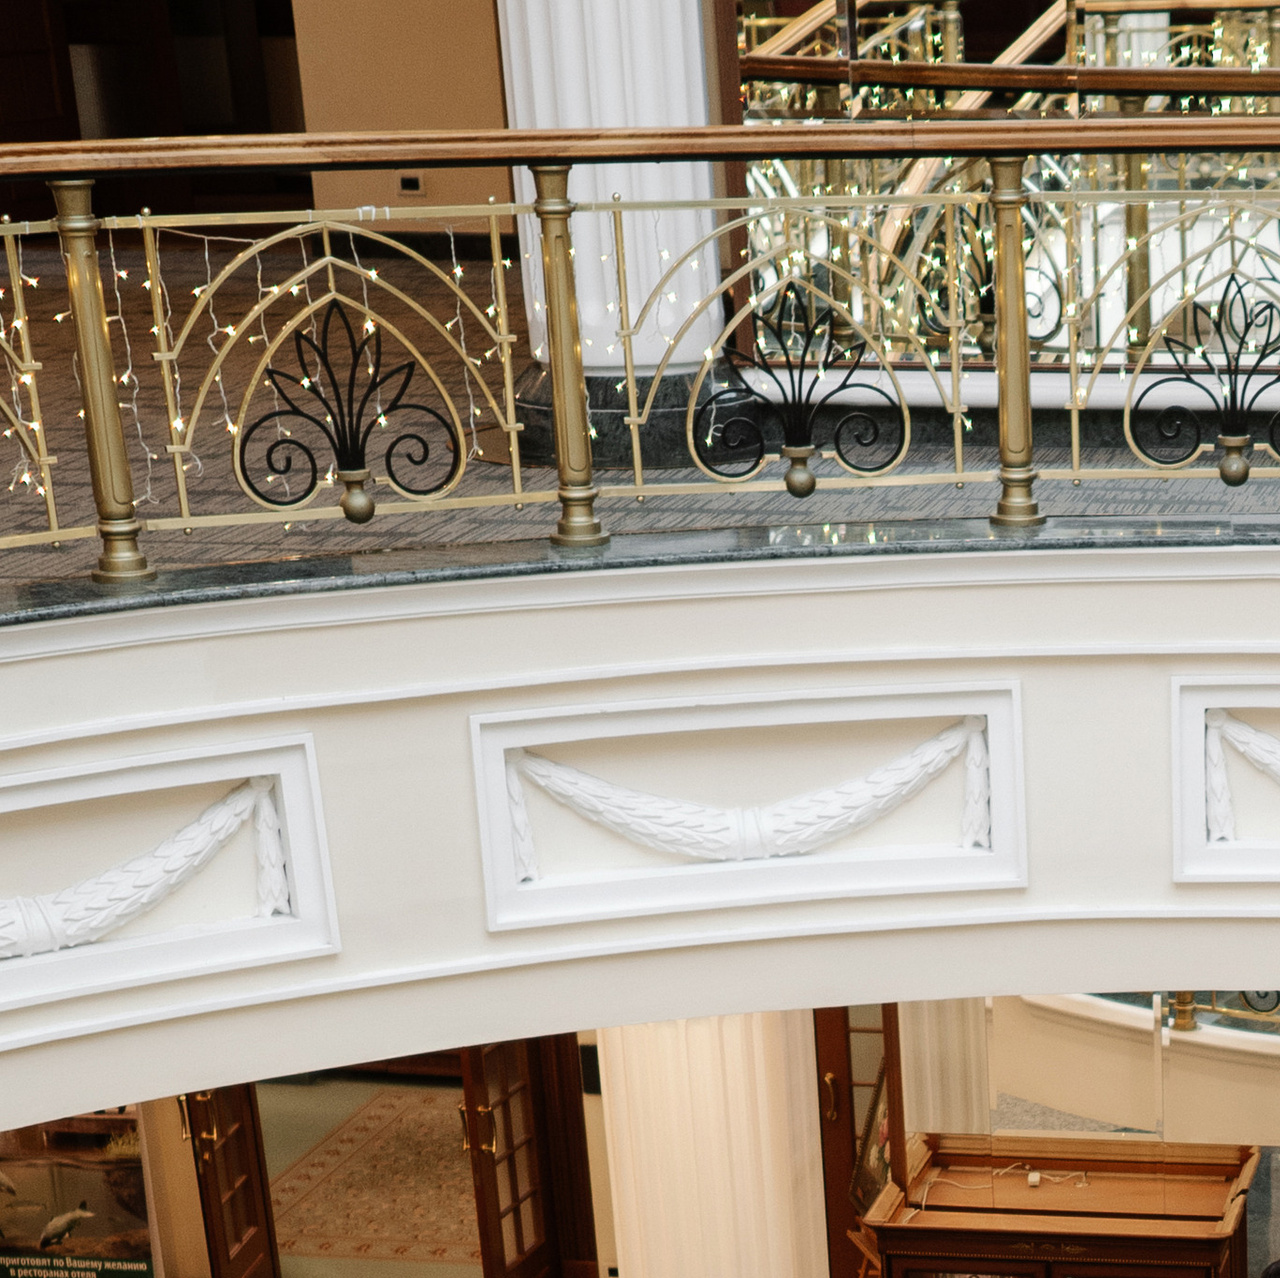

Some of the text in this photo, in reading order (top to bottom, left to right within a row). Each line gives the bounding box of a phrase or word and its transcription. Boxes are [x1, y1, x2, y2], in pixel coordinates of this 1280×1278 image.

[53, 1258, 65, 1267] по
[66, 1257, 103, 1272] Вашему
[104, 1261, 147, 1272] желанию
